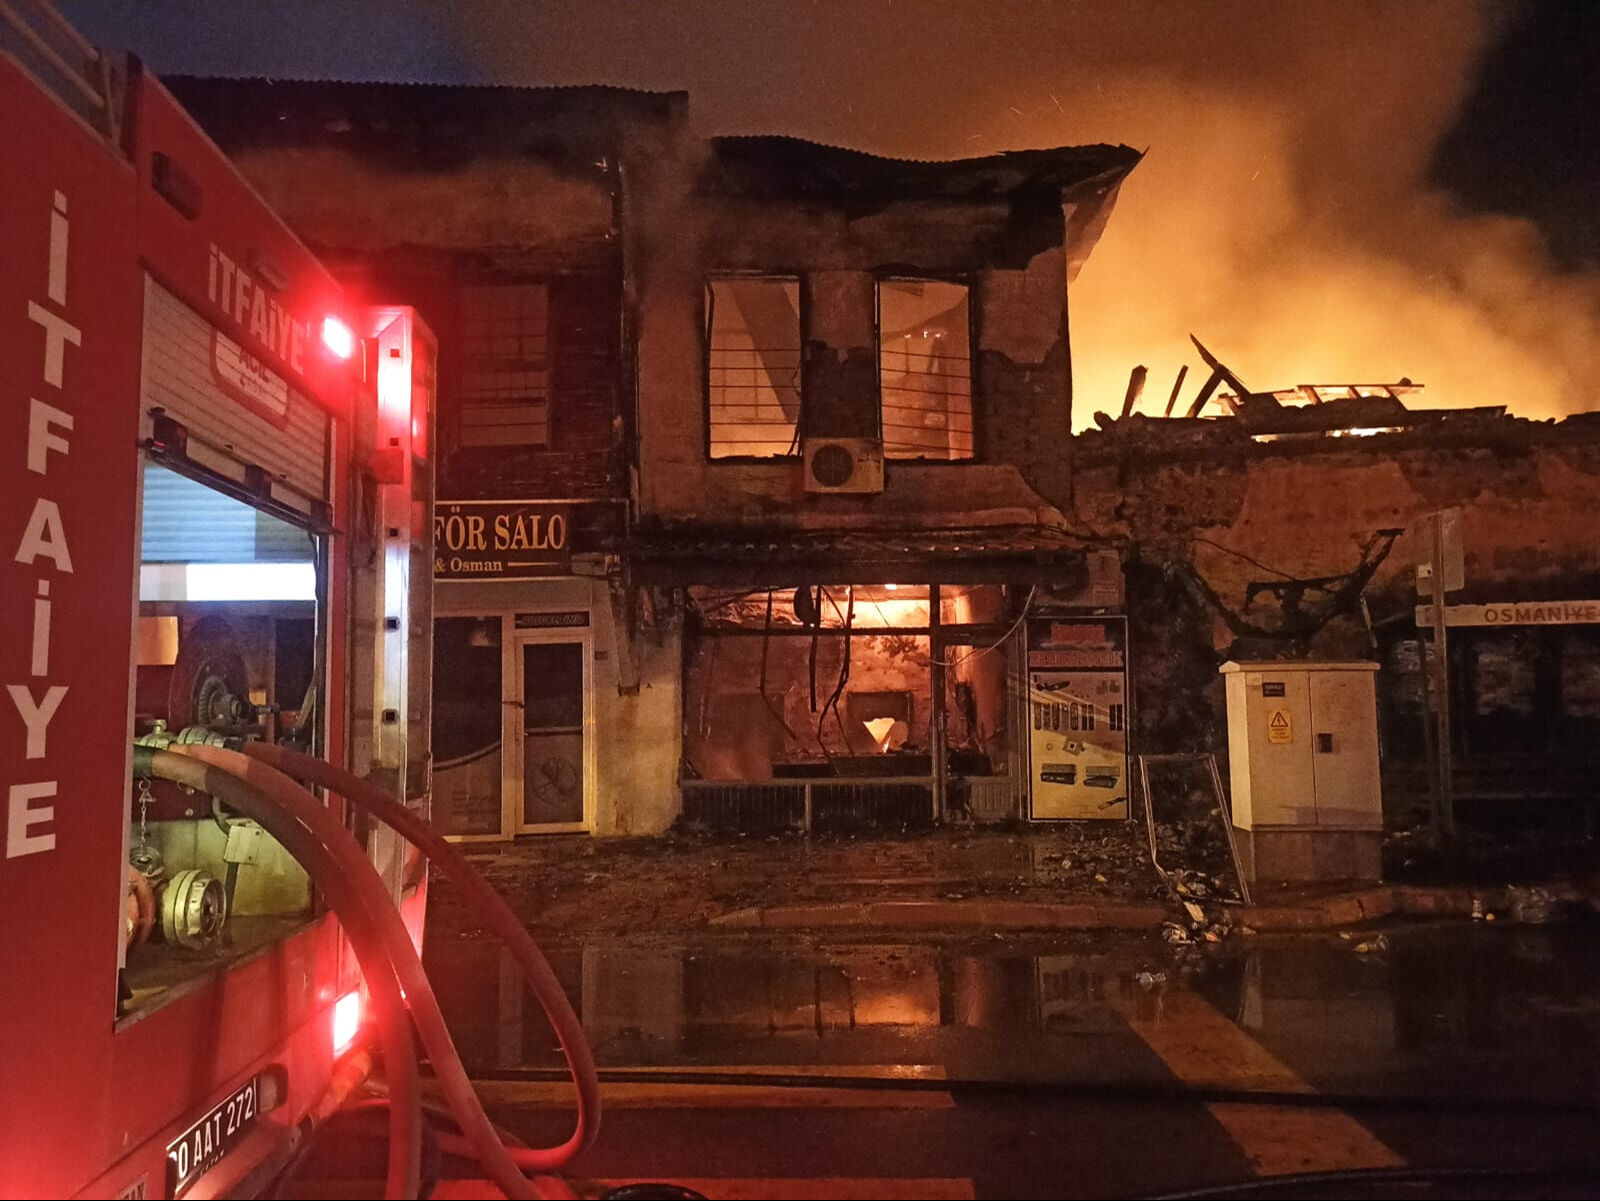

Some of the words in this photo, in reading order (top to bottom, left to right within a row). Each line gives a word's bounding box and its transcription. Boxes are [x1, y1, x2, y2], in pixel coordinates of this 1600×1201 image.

[434, 557, 446, 573] &
[450, 557, 504, 573] Osman
[193, 1111, 222, 1167] AAT
[226, 1086, 253, 1136] 272
